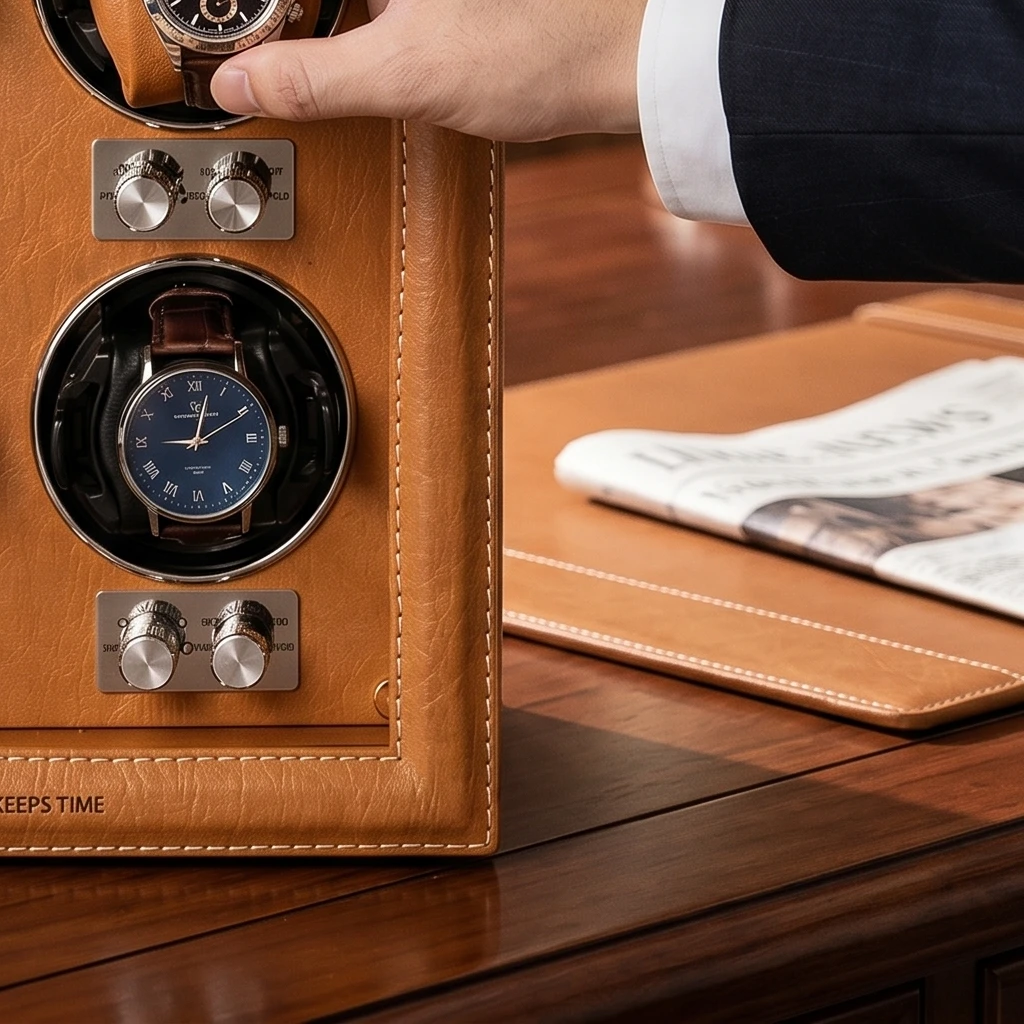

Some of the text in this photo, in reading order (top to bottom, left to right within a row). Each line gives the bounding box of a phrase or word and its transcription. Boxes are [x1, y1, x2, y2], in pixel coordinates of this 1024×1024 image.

[187, 380, 203, 392] XII
[245, 433, 258, 444] III
[222, 481, 234, 495] V
[192, 489, 205, 502] VI
[56, 795, 105, 814] TIME
